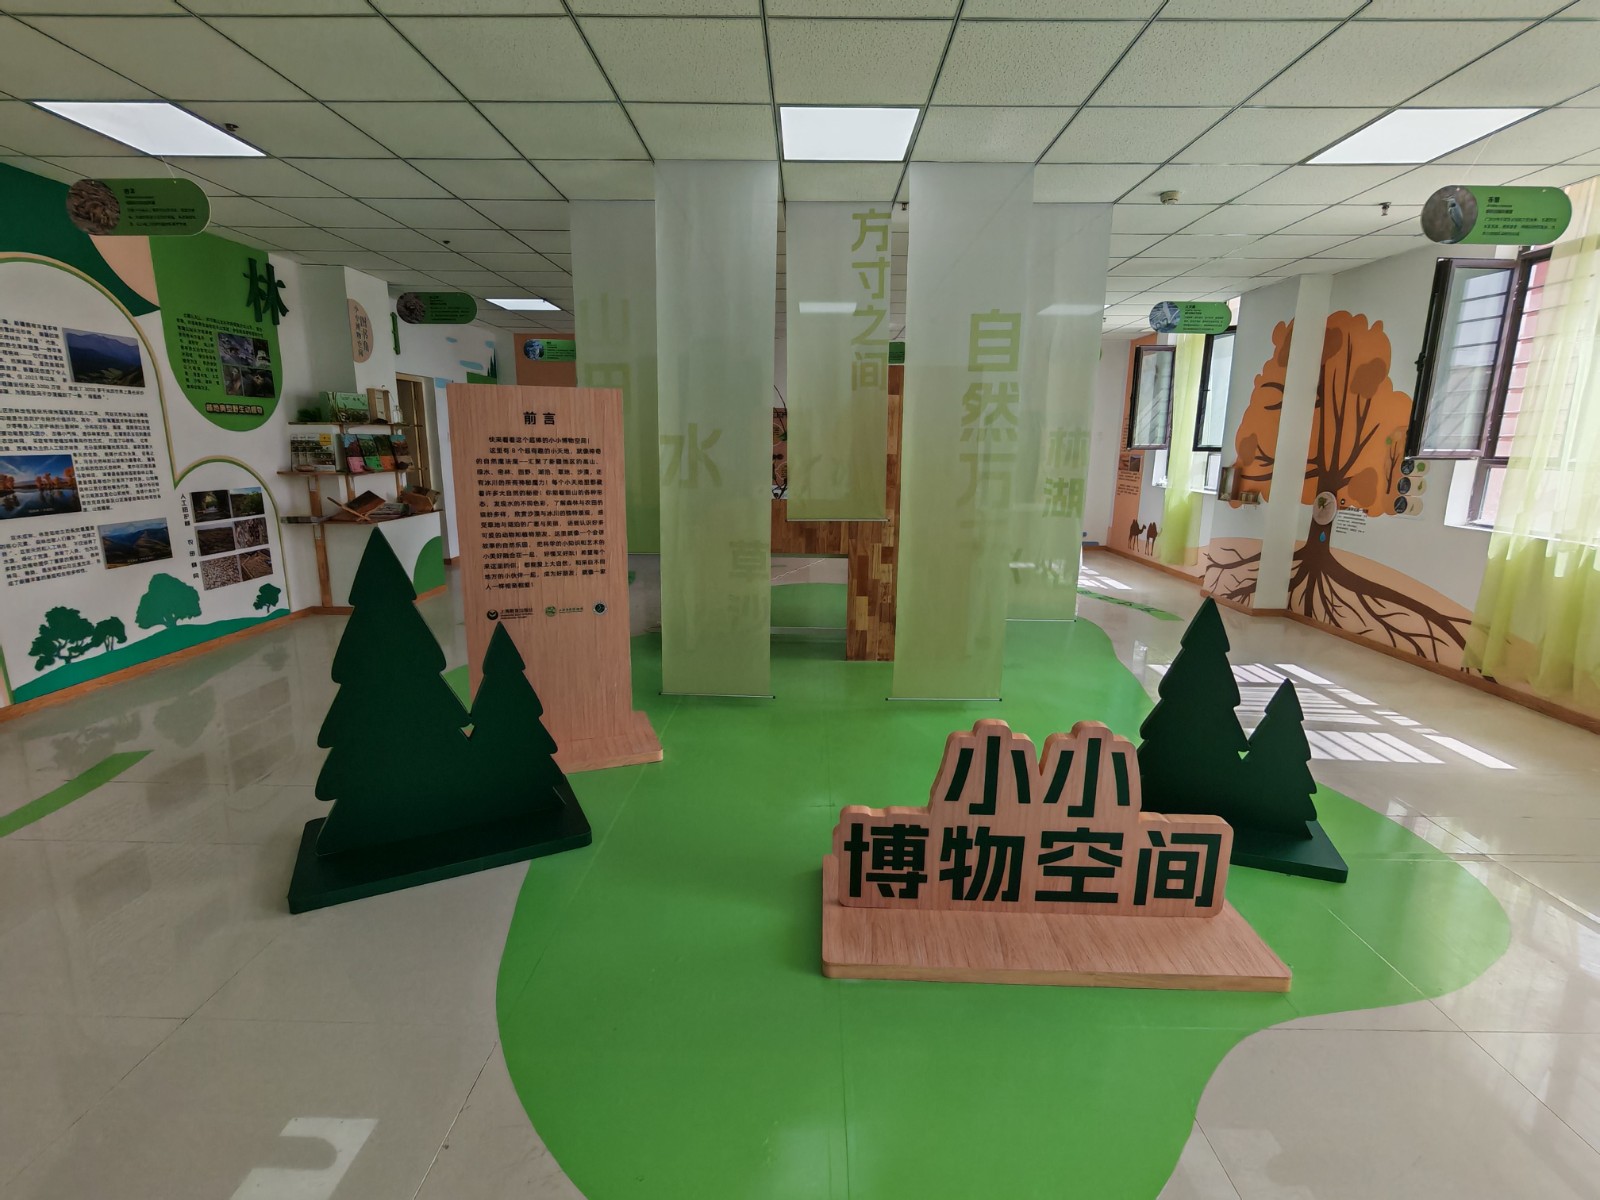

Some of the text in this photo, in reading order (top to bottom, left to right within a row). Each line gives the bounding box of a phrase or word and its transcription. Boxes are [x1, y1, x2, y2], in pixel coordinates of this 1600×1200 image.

[242, 257, 289, 325] 林
[851, 208, 892, 391] 方寸之间
[523, 411, 556, 426] 前言
[659, 422, 723, 489] 水
[1042, 426, 1091, 519] 林湖
[944, 735, 1131, 818] 小小
[844, 823, 1222, 907] 博物空间
